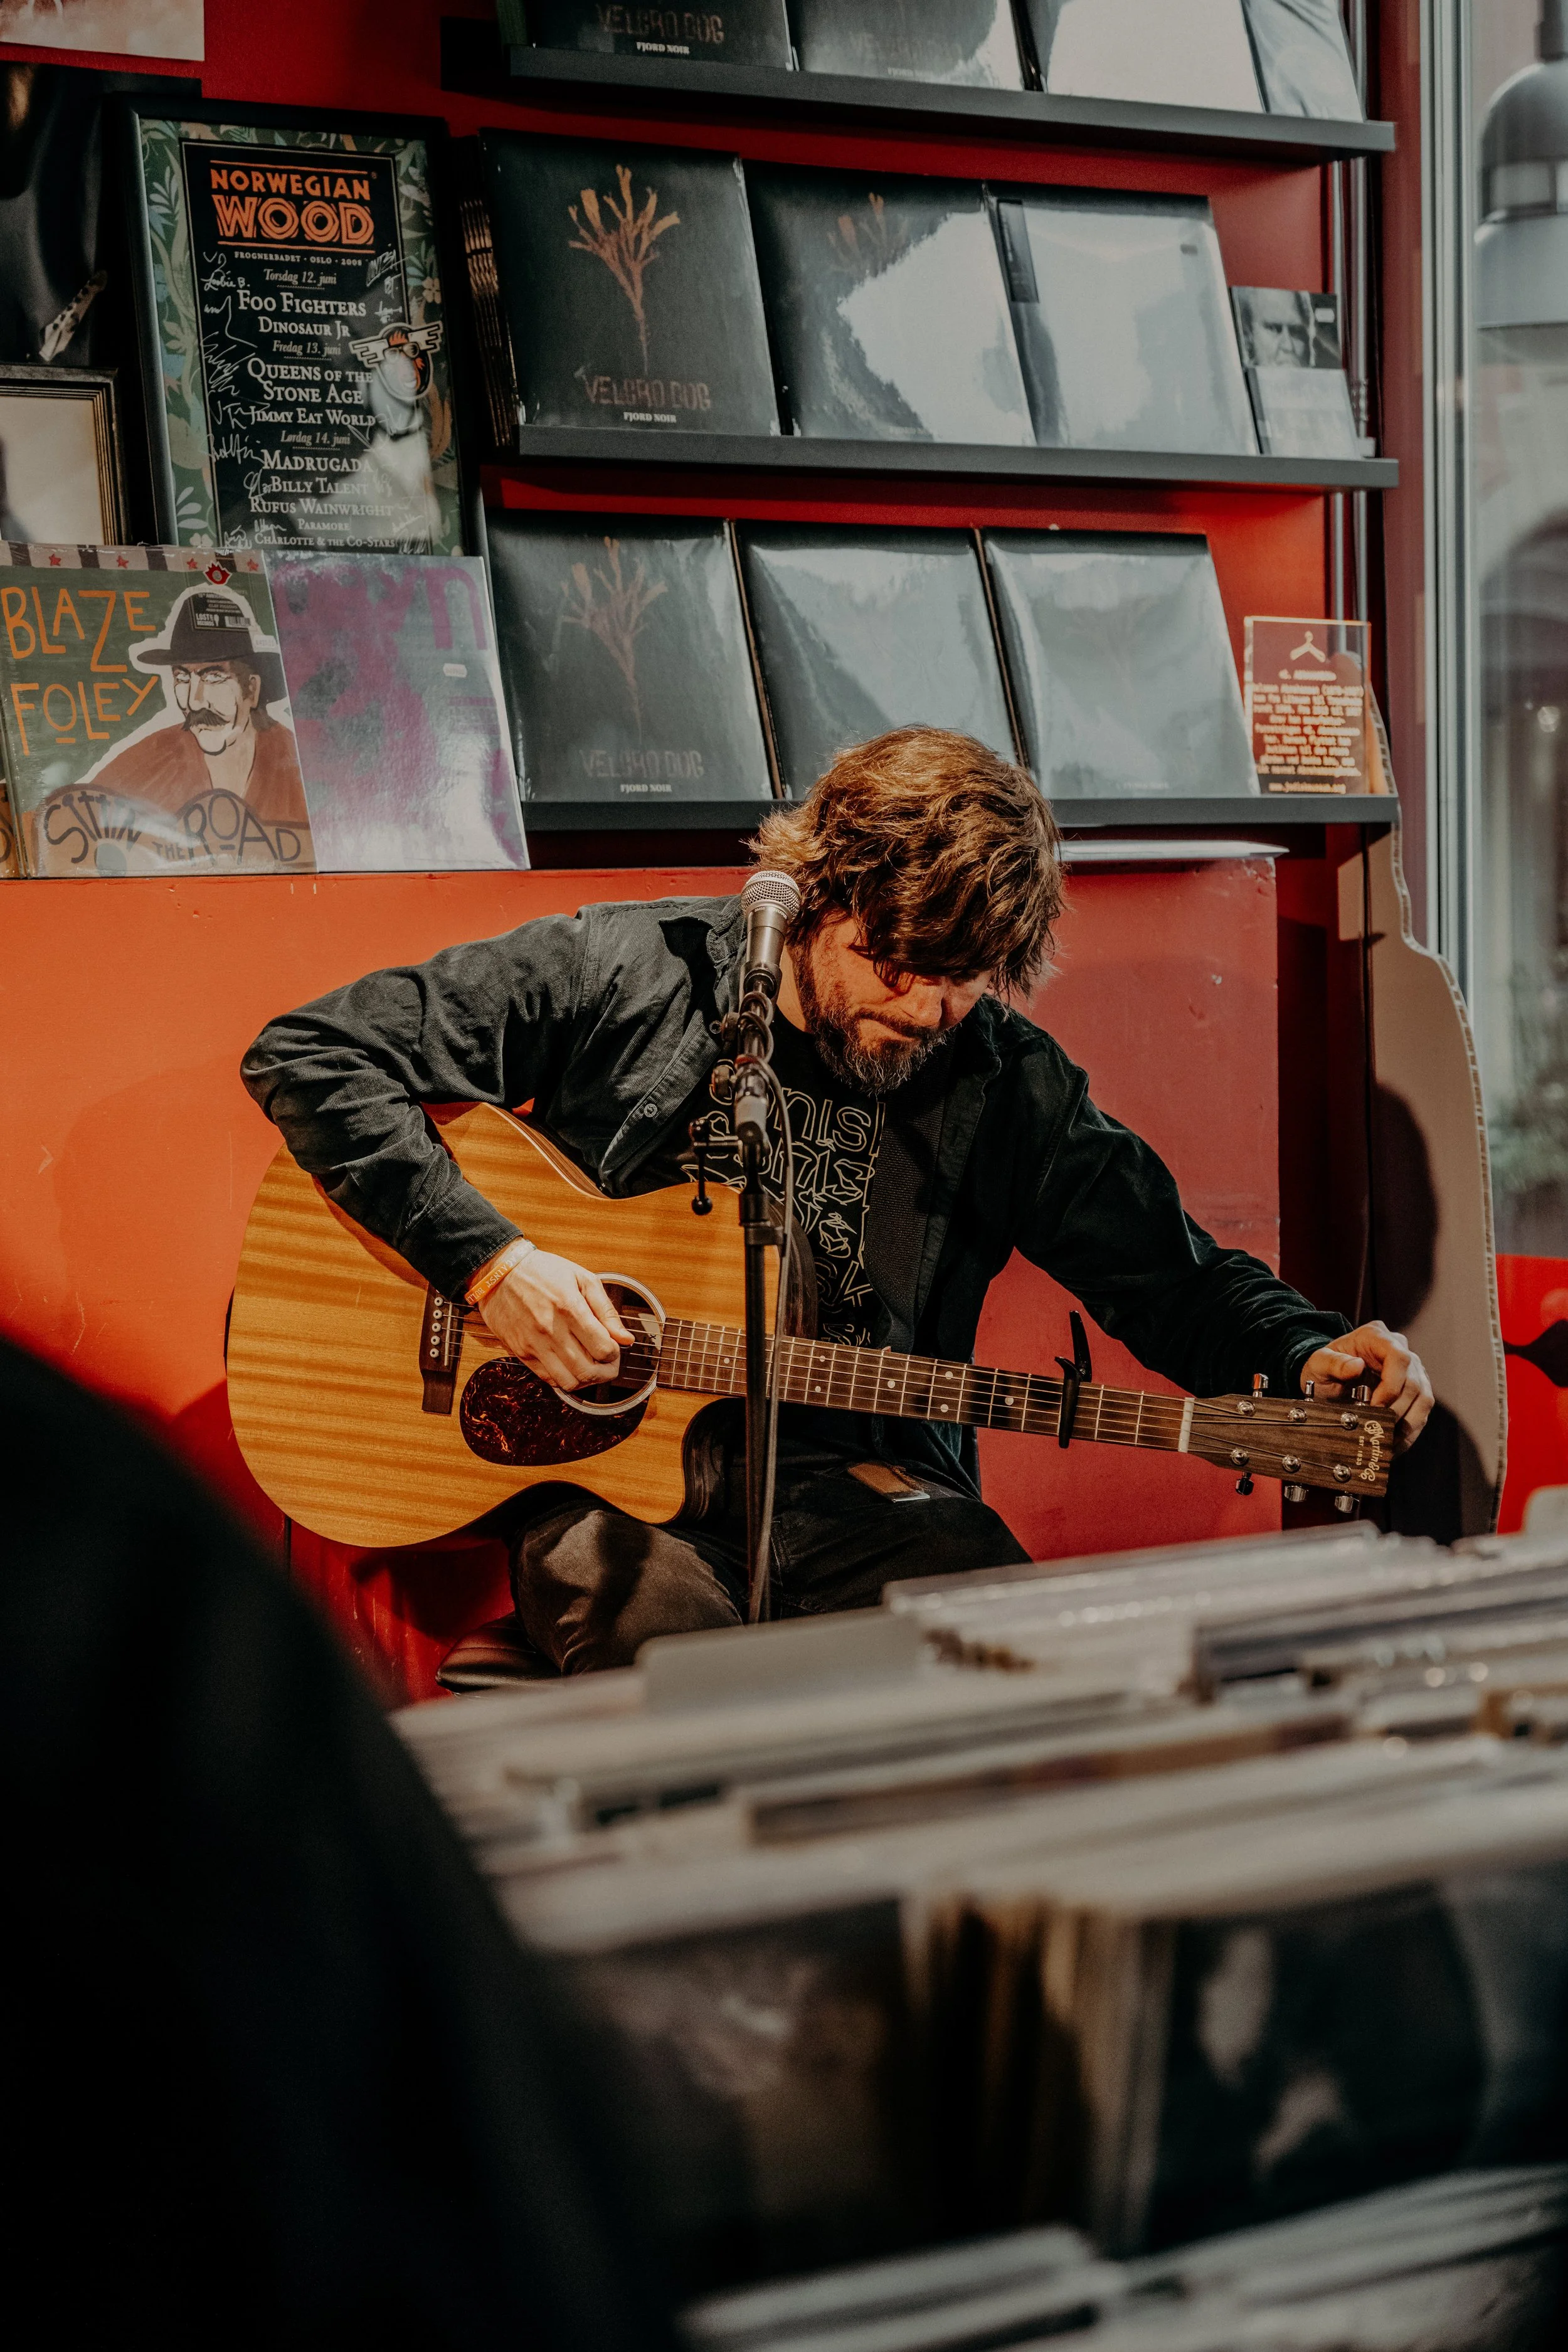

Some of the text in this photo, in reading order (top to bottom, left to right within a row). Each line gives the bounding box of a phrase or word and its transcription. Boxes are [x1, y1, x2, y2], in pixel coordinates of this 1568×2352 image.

[636, 41, 665, 53] FJORD
[210, 169, 371, 201] NORWEGIAN
[212, 194, 375, 245] WOOD
[235, 251, 301, 262] FROGNERBADET
[310, 257, 332, 265] OSLO
[263, 268, 337, 286] Torsdag 12. juni
[272, 340, 341, 357] Fredag 13. juni
[623, 411, 677, 423] FJORD NOIR
[280, 430, 351, 447] Lørdag 14. juni
[317, 537, 326, 546] &
[1, 586, 156, 672] BLAZE
[10, 676, 159, 756] FOLEY
[152, 841, 186, 861] THE
[184, 793, 301, 866] ROAD
